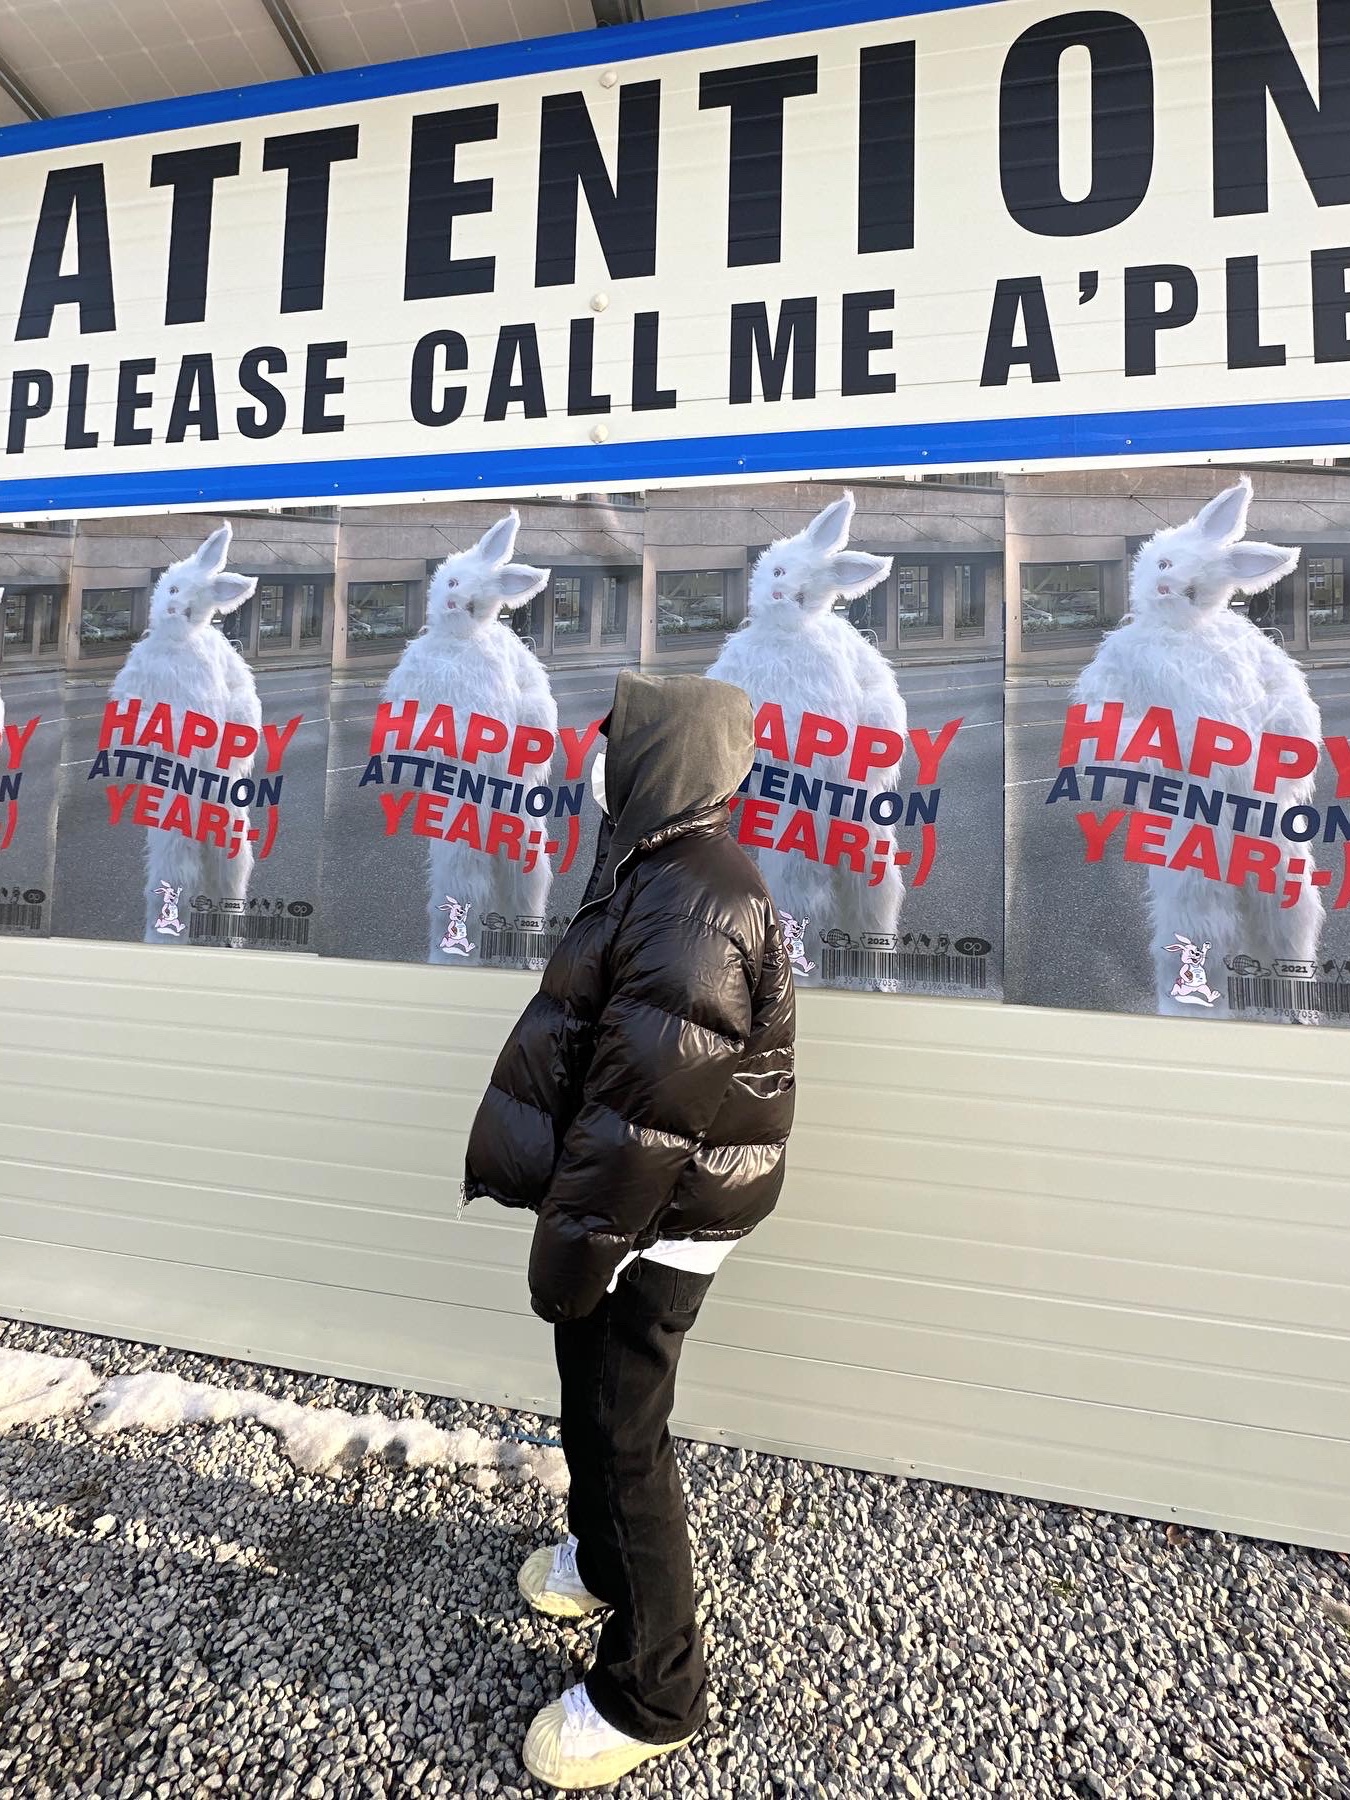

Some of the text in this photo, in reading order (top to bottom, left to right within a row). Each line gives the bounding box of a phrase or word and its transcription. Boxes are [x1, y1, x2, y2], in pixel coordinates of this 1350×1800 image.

[15, 0, 1350, 341] ATTENTION
[6, 341, 348, 454] PLEASE
[410, 311, 677, 427] CALL
[729, 289, 896, 405] ME
[97, 698, 304, 773] HAPPY
[369, 699, 613, 781] HAPPY
[754, 702, 964, 785] APPY
[88, 749, 283, 808] ATTENTION
[358, 754, 585, 818] ATTENTION
[738, 761, 941, 827] TENTION
[1045, 766, 1350, 843] ATTENTION
[728, 797, 937, 887] EAR;-)
[520, 919, 540, 928] 2021
[867, 937, 890, 946] 2021
[1281, 964, 1308, 973] 2021
